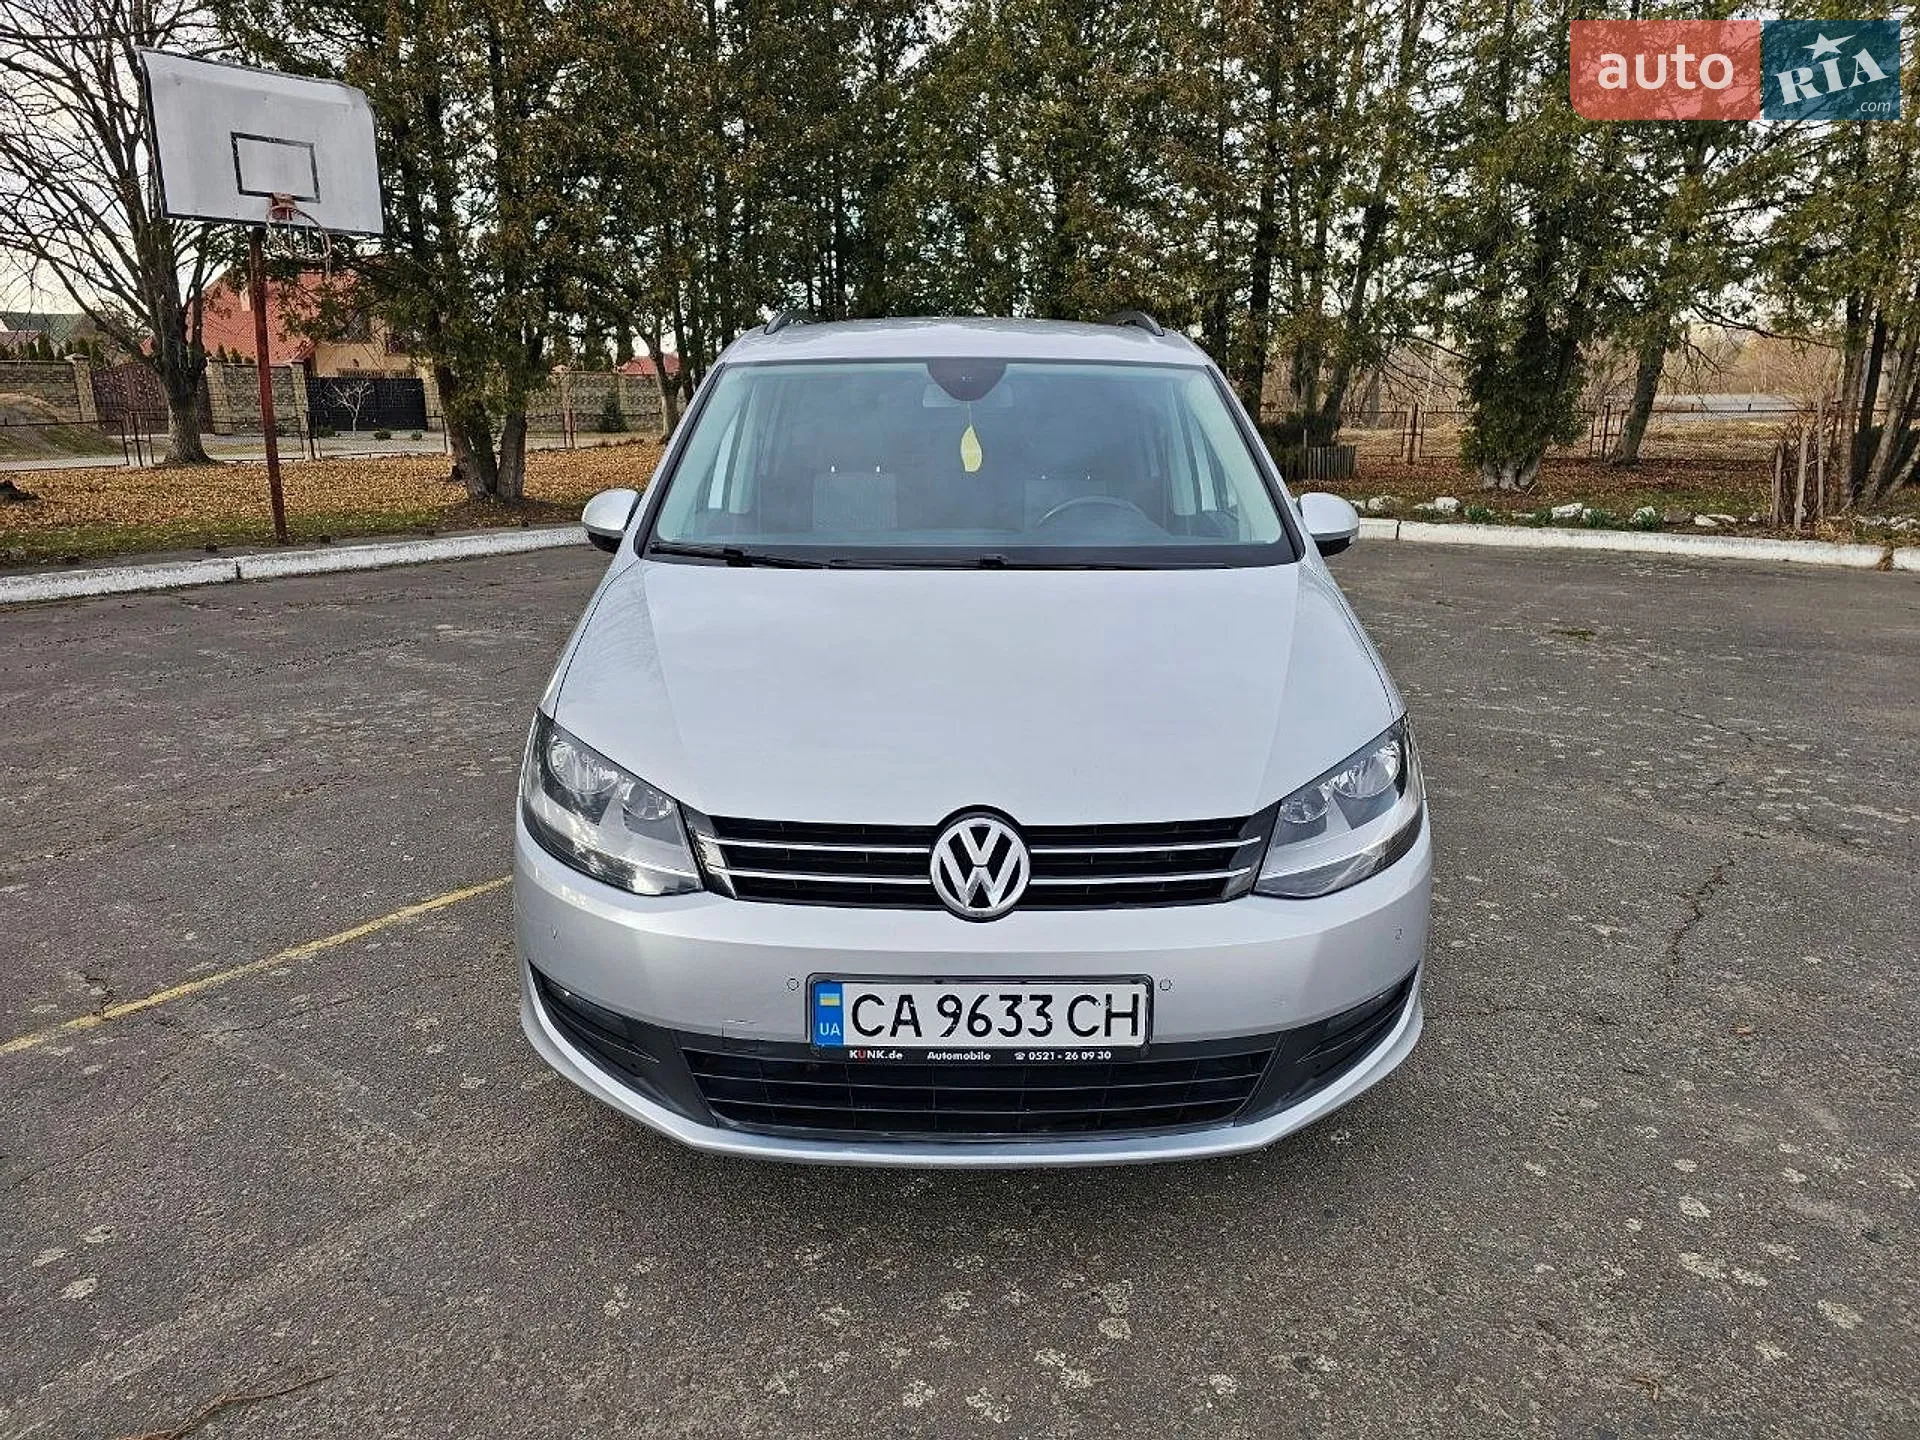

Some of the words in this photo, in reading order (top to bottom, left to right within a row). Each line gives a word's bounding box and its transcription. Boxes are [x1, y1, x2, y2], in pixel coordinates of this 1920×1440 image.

[851, 994, 922, 1037] CA
[936, 994, 1053, 1037] 9633
[1066, 993, 1139, 1037] CH
[819, 1023, 840, 1036] UA
[927, 1051, 991, 1061] Automobile
[1028, 1051, 1055, 1060] 0521
[1064, 1051, 1079, 1060] 26
